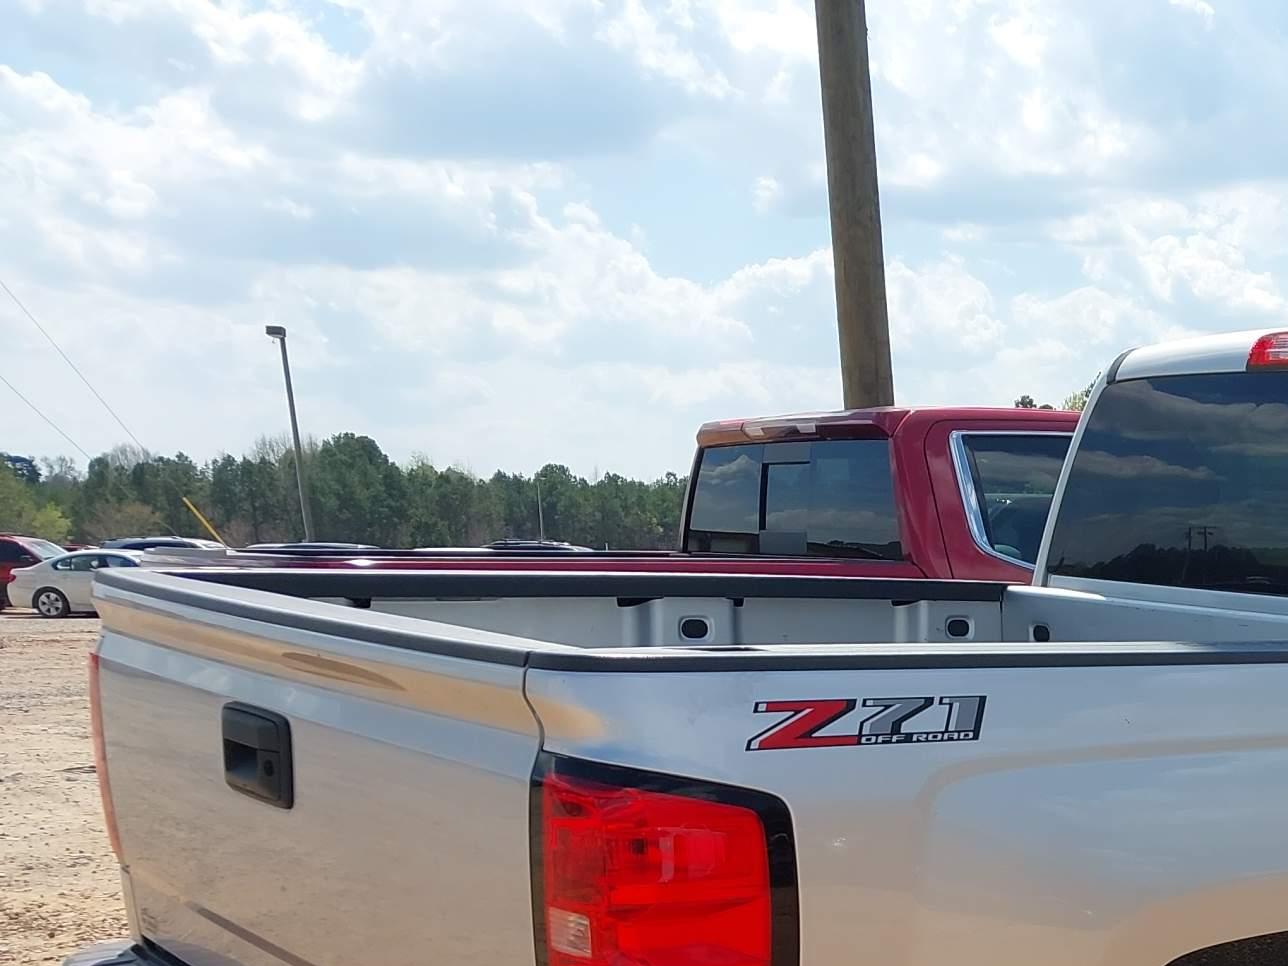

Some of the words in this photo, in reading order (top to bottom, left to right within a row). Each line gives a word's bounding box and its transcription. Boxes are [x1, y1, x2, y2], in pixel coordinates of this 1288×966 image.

[745, 695, 987, 751] Z71
[860, 733, 907, 744] OFF
[911, 730, 975, 743] ROAD
